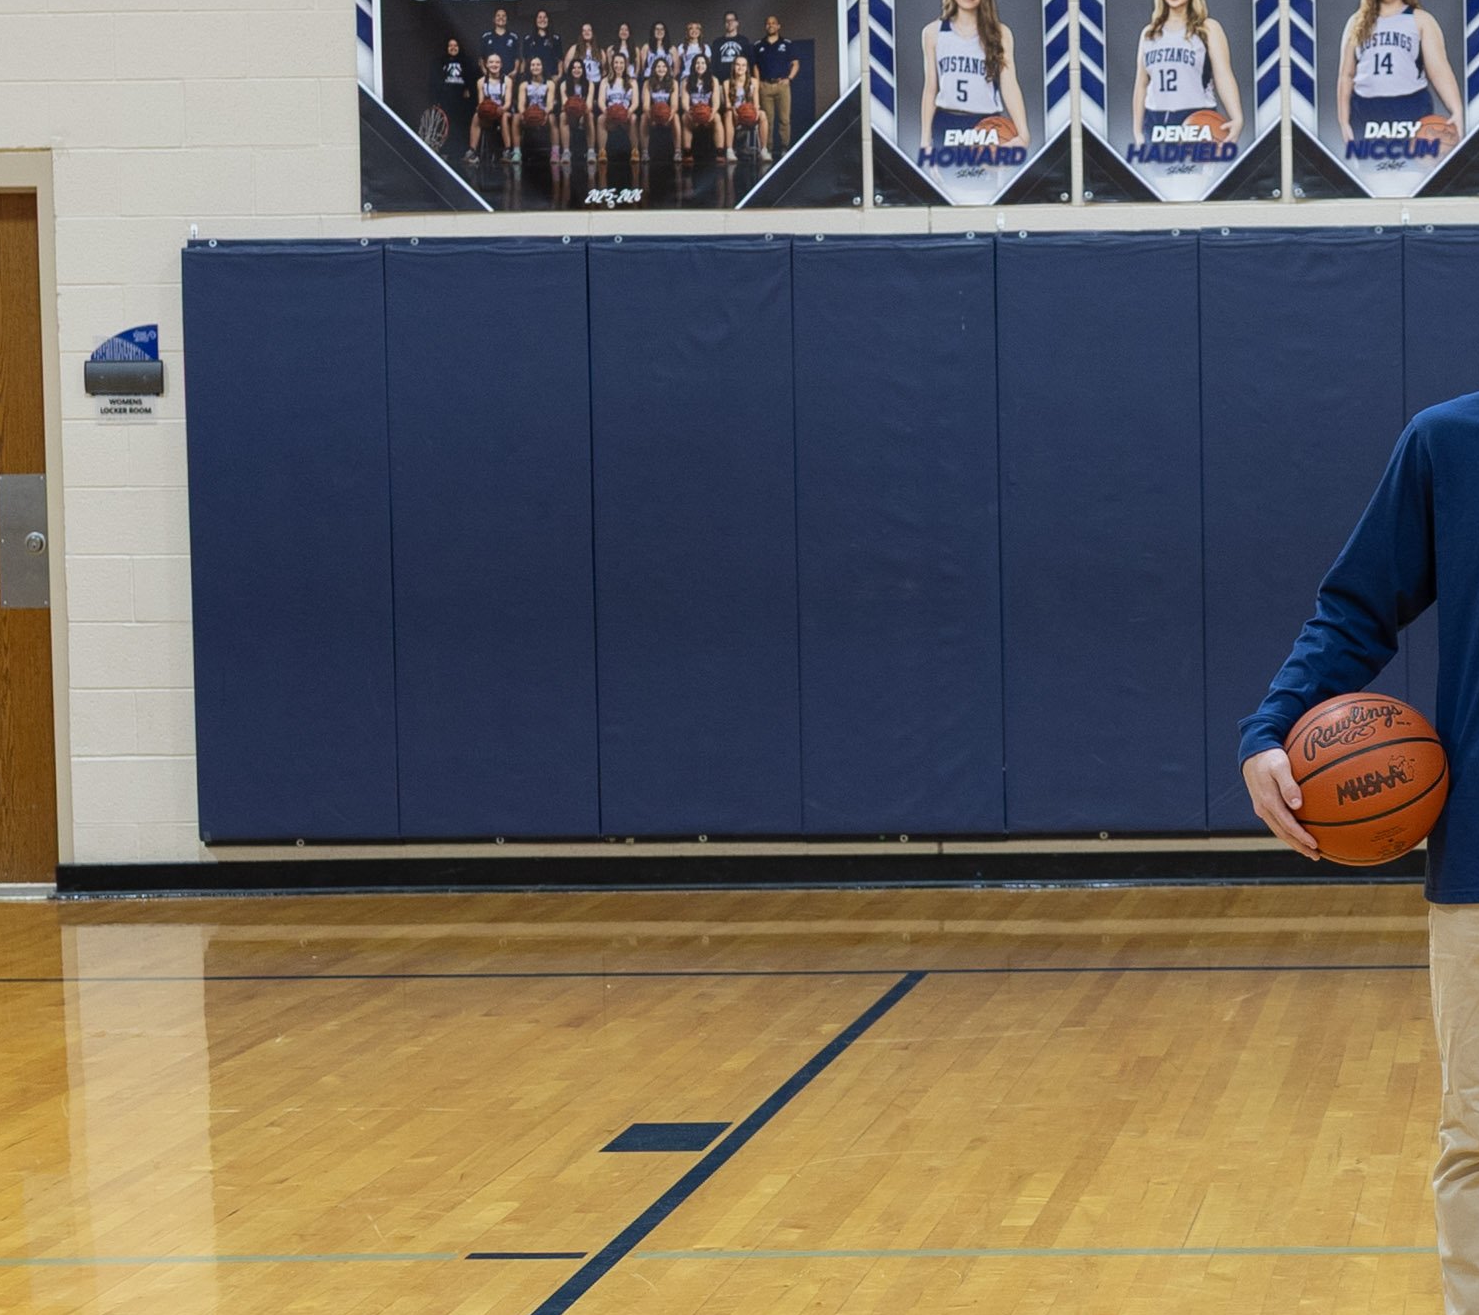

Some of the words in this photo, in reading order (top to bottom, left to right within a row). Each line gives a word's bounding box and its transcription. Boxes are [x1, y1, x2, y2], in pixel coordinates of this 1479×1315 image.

[1373, 53, 1392, 75] 14
[1159, 69, 1177, 91] 12
[957, 80, 968, 102] 5
[944, 129, 999, 146] EMMA
[1152, 125, 1212, 142] DENEA
[1365, 121, 1421, 139] DAISY
[918, 147, 1027, 167] HOWARD
[1126, 142, 1238, 165] HADFIELD
[1345, 139, 1439, 160] NICCUM
[1304, 704, 1402, 761] Rawlings
